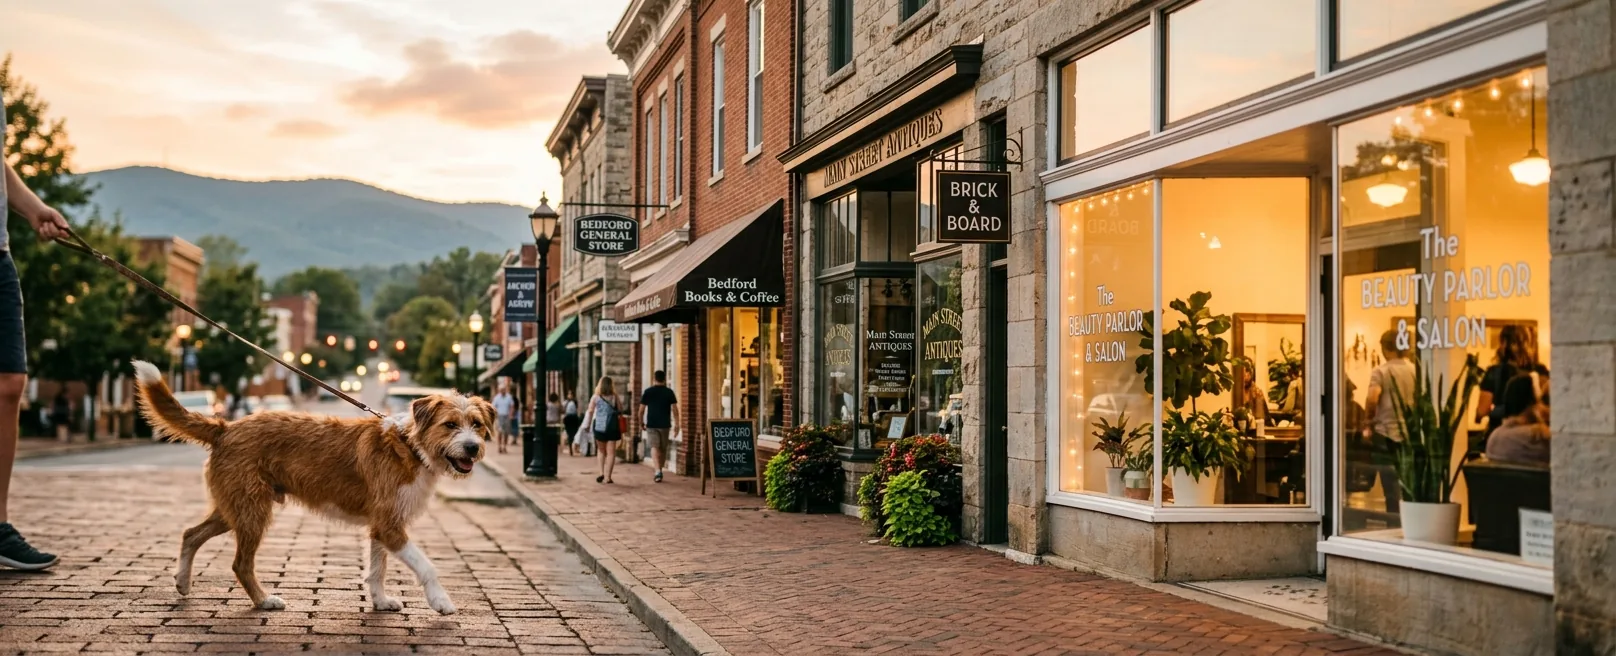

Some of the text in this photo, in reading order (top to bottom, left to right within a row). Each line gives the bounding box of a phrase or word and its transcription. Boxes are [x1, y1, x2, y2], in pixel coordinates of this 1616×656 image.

[950, 181, 998, 198] BRICK
[968, 199, 980, 214] &
[947, 215, 1002, 232] BOARD
[579, 230, 632, 240] GENERAL
[1419, 225, 1459, 260] The
[588, 241, 624, 251] STORE
[707, 277, 757, 290] Bedford
[1361, 260, 1531, 310] BEAUTY PARLOR
[684, 290, 779, 303] Books & Coffee
[1097, 285, 1113, 305] The
[922, 310, 940, 340] MAIN
[1069, 310, 1143, 336] BEAUTY PARLOR
[1395, 314, 1487, 351] & SALON
[1085, 341, 1126, 363] & SALON
[715, 440, 752, 451] GENERAL
[721, 452, 748, 464] STORE
